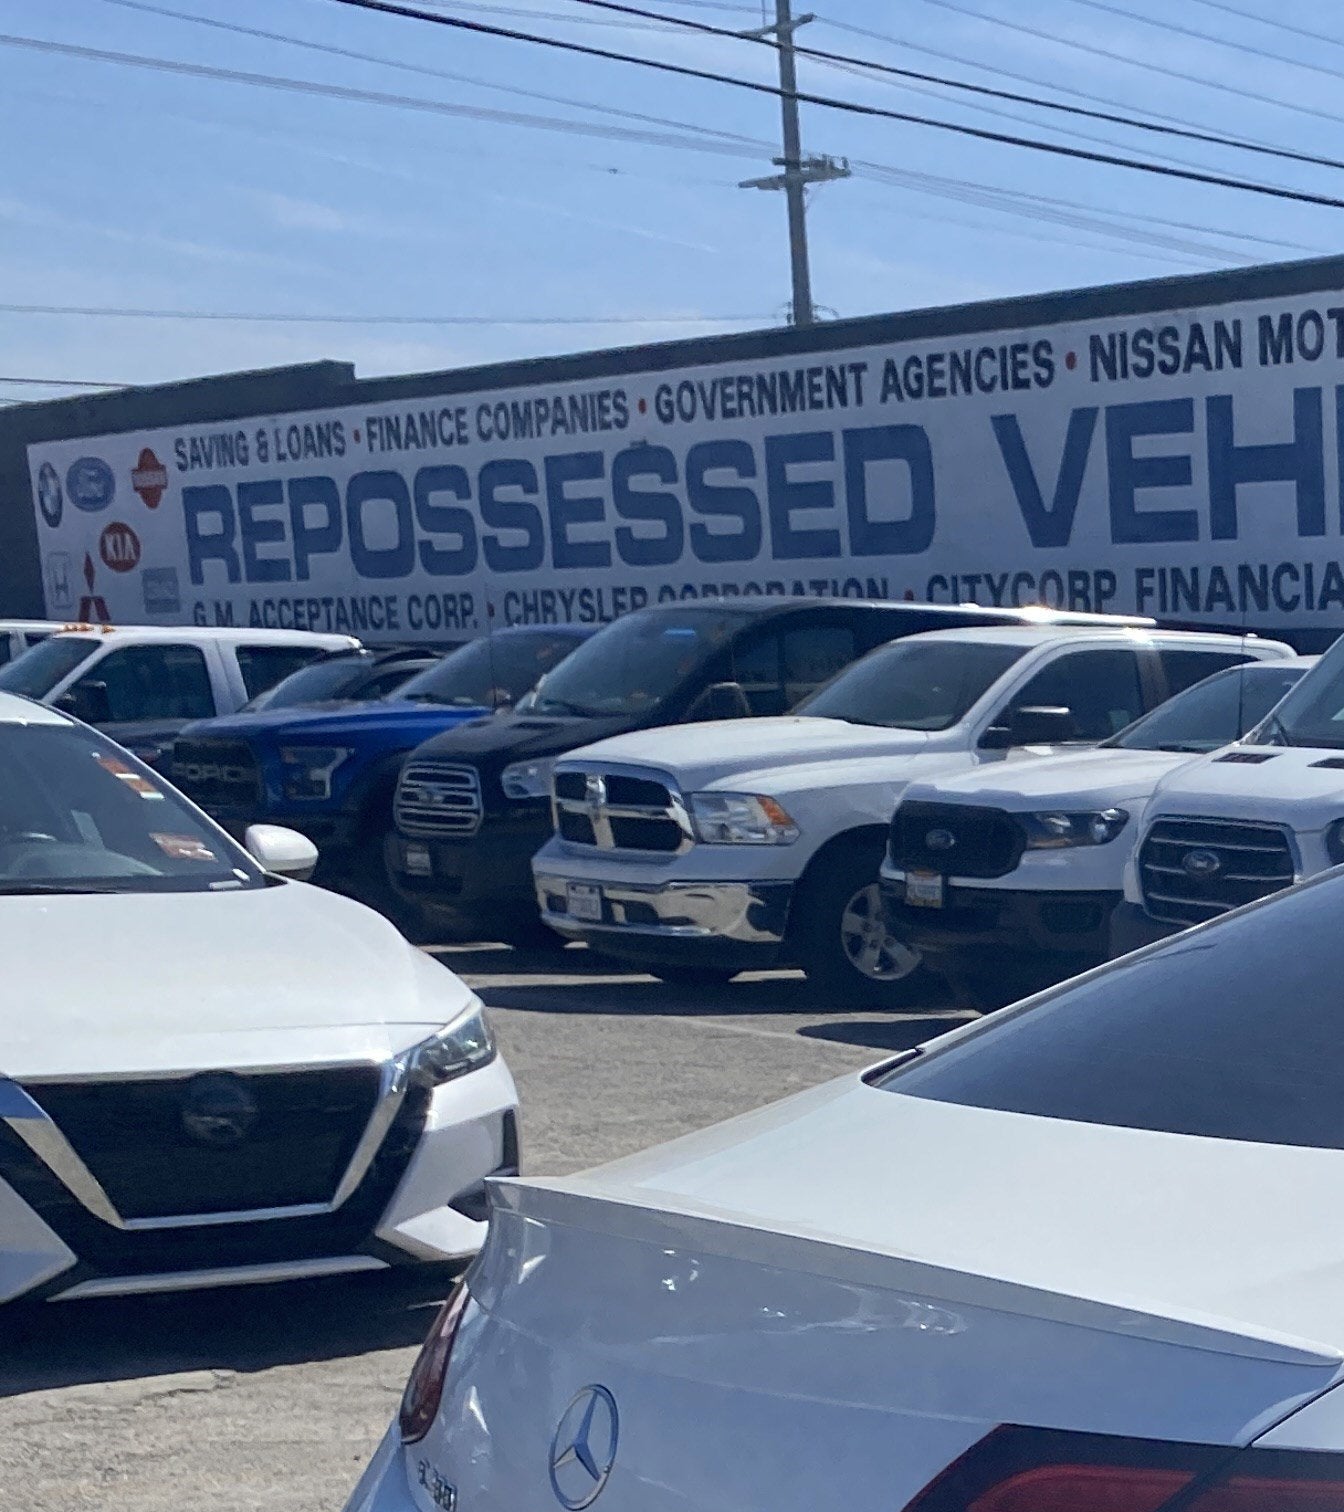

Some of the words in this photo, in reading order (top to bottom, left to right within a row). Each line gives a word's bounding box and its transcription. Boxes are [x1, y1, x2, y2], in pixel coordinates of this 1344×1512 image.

[174, 431, 250, 472] SAVING
[256, 431, 269, 463] &
[274, 421, 346, 460] LOANS
[365, 408, 470, 453] FINANCE
[476, 390, 630, 442] COMPANIES
[654, 362, 868, 424] GOVERNMENT
[879, 340, 1056, 404] AGENCIES
[1089, 320, 1243, 382] NISSAN
[182, 423, 937, 585] REPOSSESSED
[249, 596, 400, 630] ACCEPTANCE
[406, 591, 478, 631] CORP.
[926, 568, 1116, 613] CITYCORP
